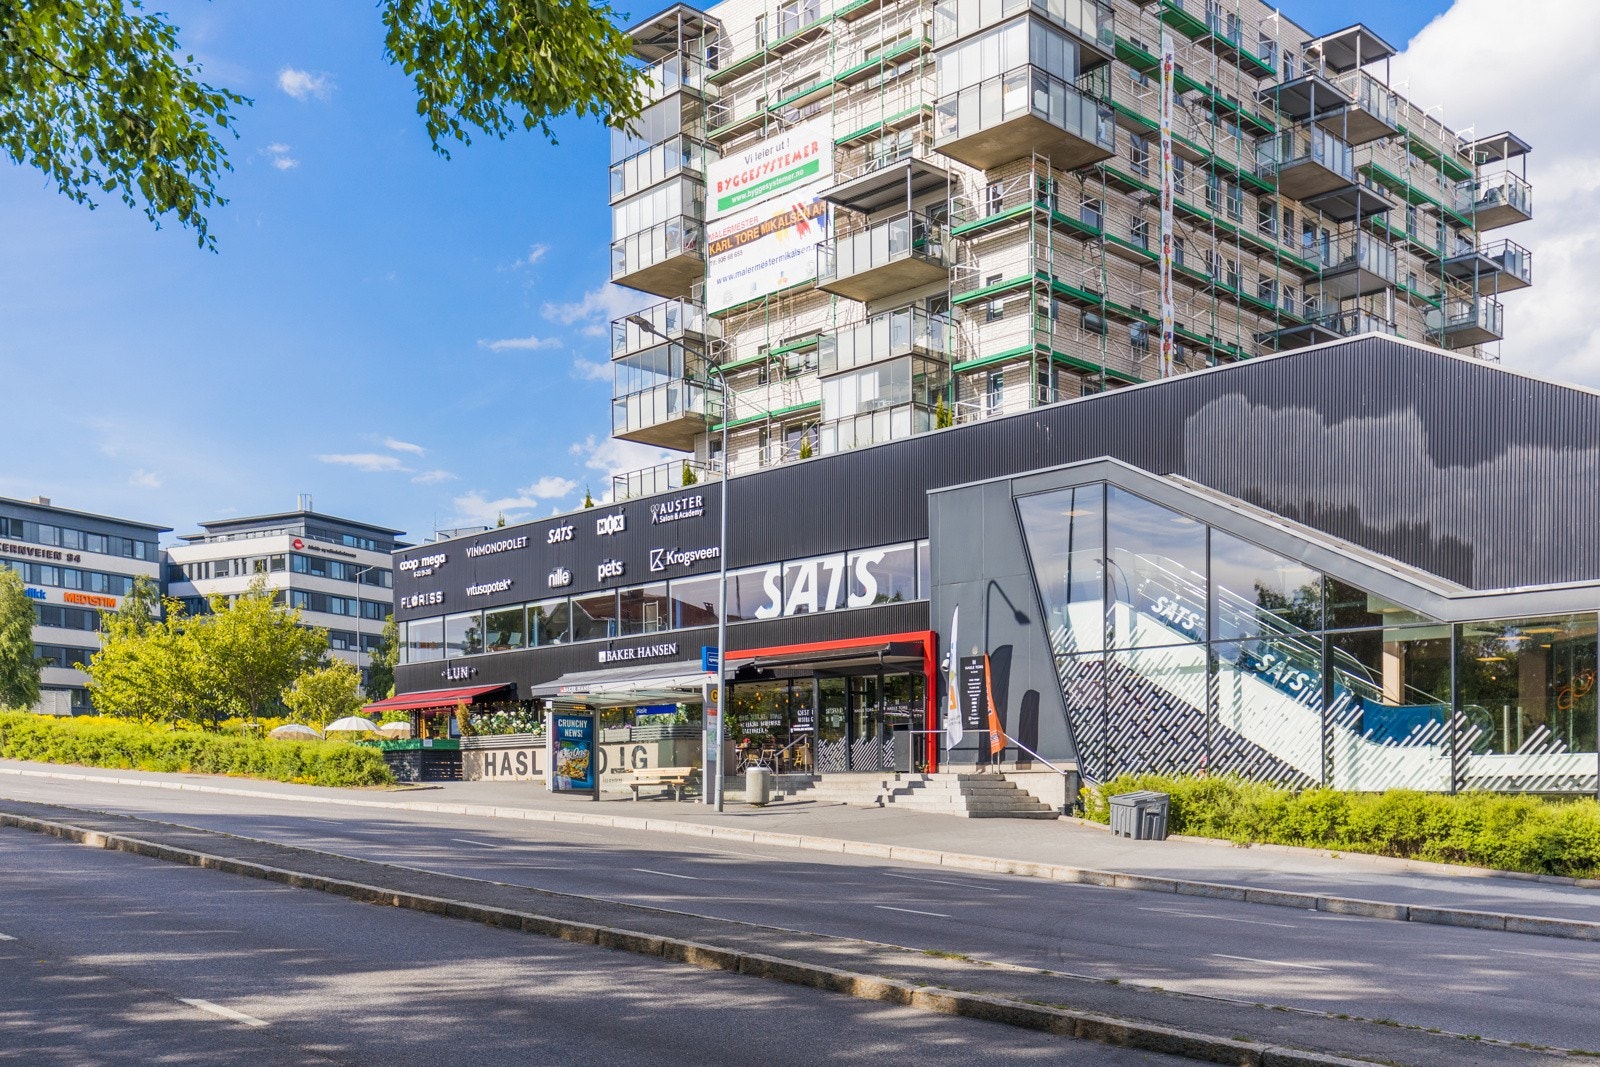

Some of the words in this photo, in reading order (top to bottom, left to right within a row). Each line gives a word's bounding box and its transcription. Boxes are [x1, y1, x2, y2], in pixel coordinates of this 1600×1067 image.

[745, 155, 753, 164] Vi
[755, 147, 773, 160] leier
[776, 142, 785, 152] ut
[717, 141, 819, 193] BYGGESYSTEMER
[731, 169, 804, 203] www.byggesystemer.no
[708, 216, 759, 240] MALERMESTER
[709, 239, 732, 256] KARL
[735, 227, 760, 243] TORE
[761, 207, 811, 235] MIKALSEN
[660, 495, 702, 514] AUSTER
[597, 516, 623, 534] MIX
[660, 514, 673, 523] Salon
[679, 508, 703, 520] Academy
[547, 526, 573, 544] SATS
[0, 542, 62, 561] ERNVEIEN
[466, 537, 527, 557] VINMONOPOLET
[667, 547, 720, 566] Krogsveen
[400, 559, 418, 570] coop
[421, 553, 446, 568] mega
[598, 560, 623, 581] pets
[549, 569, 569, 587] nille
[755, 552, 886, 619] SATS
[1151, 596, 1201, 630] SATS
[606, 649, 635, 661] BAKER
[637, 643, 676, 659] HANSEN
[447, 666, 468, 680] LUN
[1255, 654, 1309, 691] SATS
[558, 719, 587, 728] CRUNCHY
[564, 729, 583, 737] NEWS!
[484, 750, 544, 776] HASL
